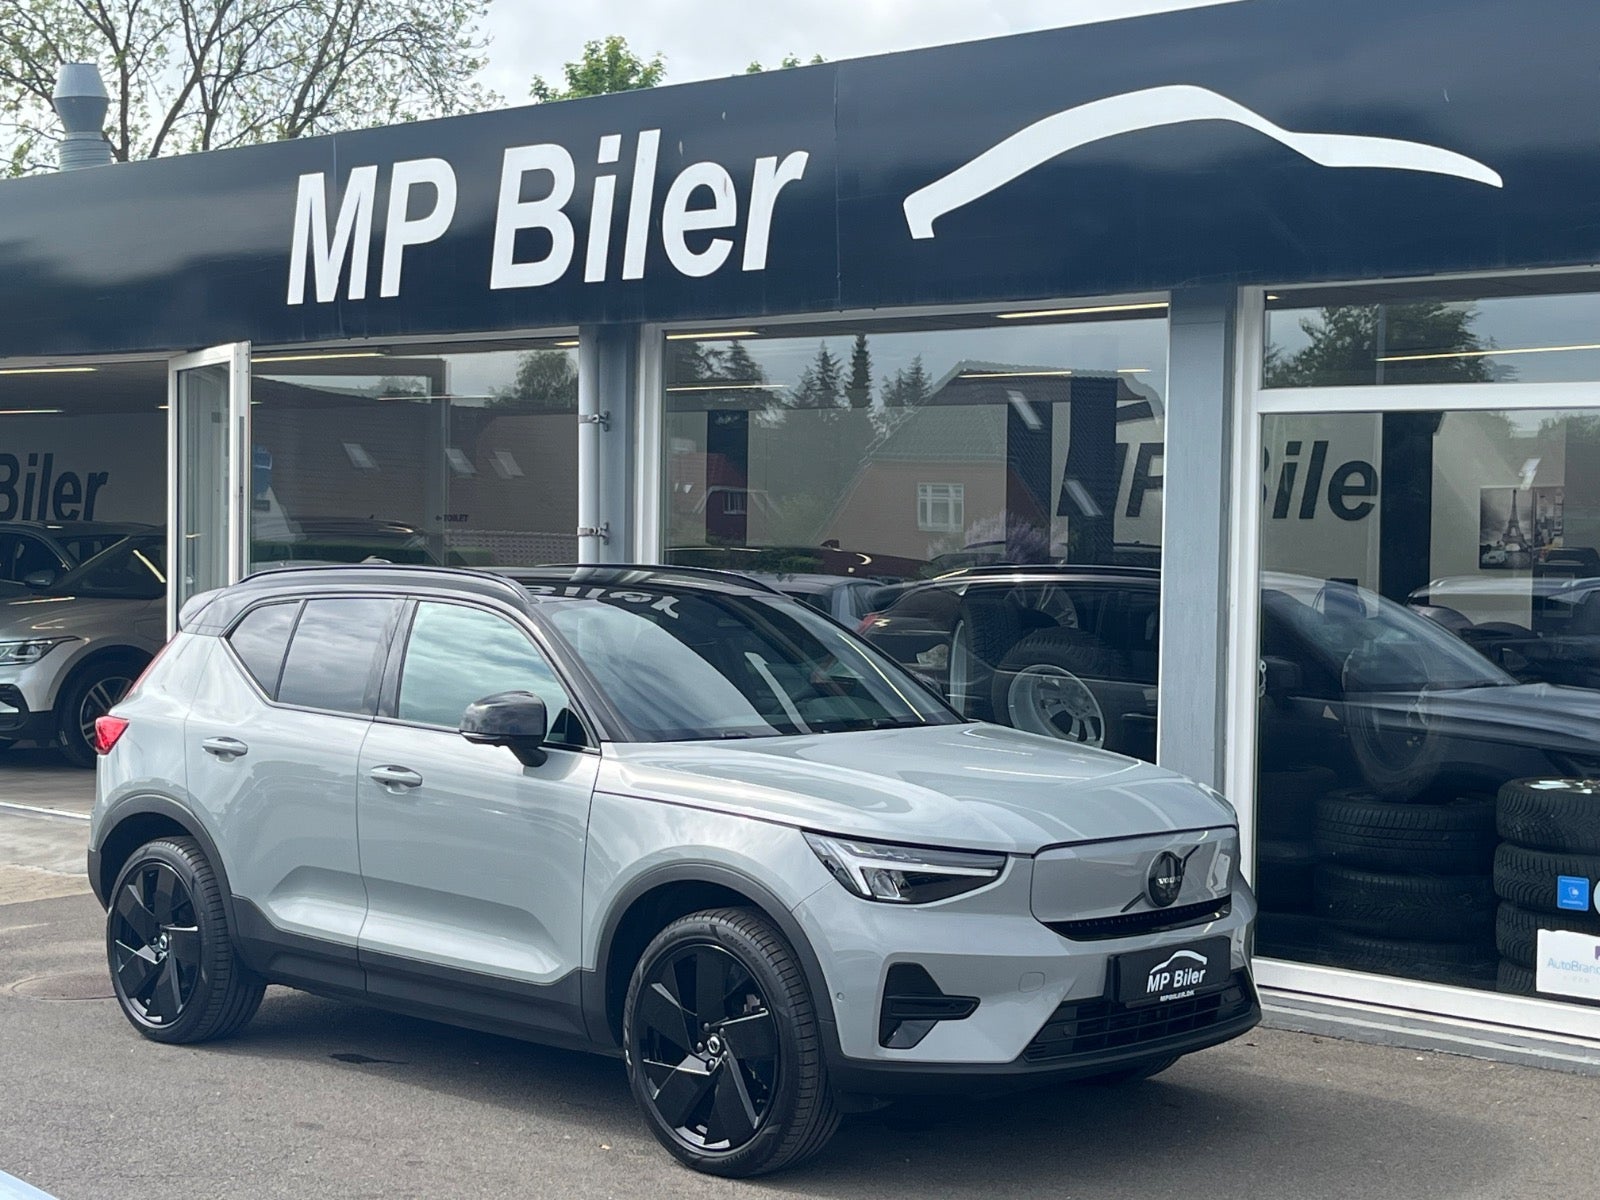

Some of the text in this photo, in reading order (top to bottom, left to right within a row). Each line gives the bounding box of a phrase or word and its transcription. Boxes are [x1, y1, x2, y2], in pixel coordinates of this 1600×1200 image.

[287, 128, 809, 305] MP Biler
[0, 453, 109, 521] Biler
[1146, 967, 1206, 993] MP Biler
[1160, 990, 1195, 1002] MPBILER.DK
